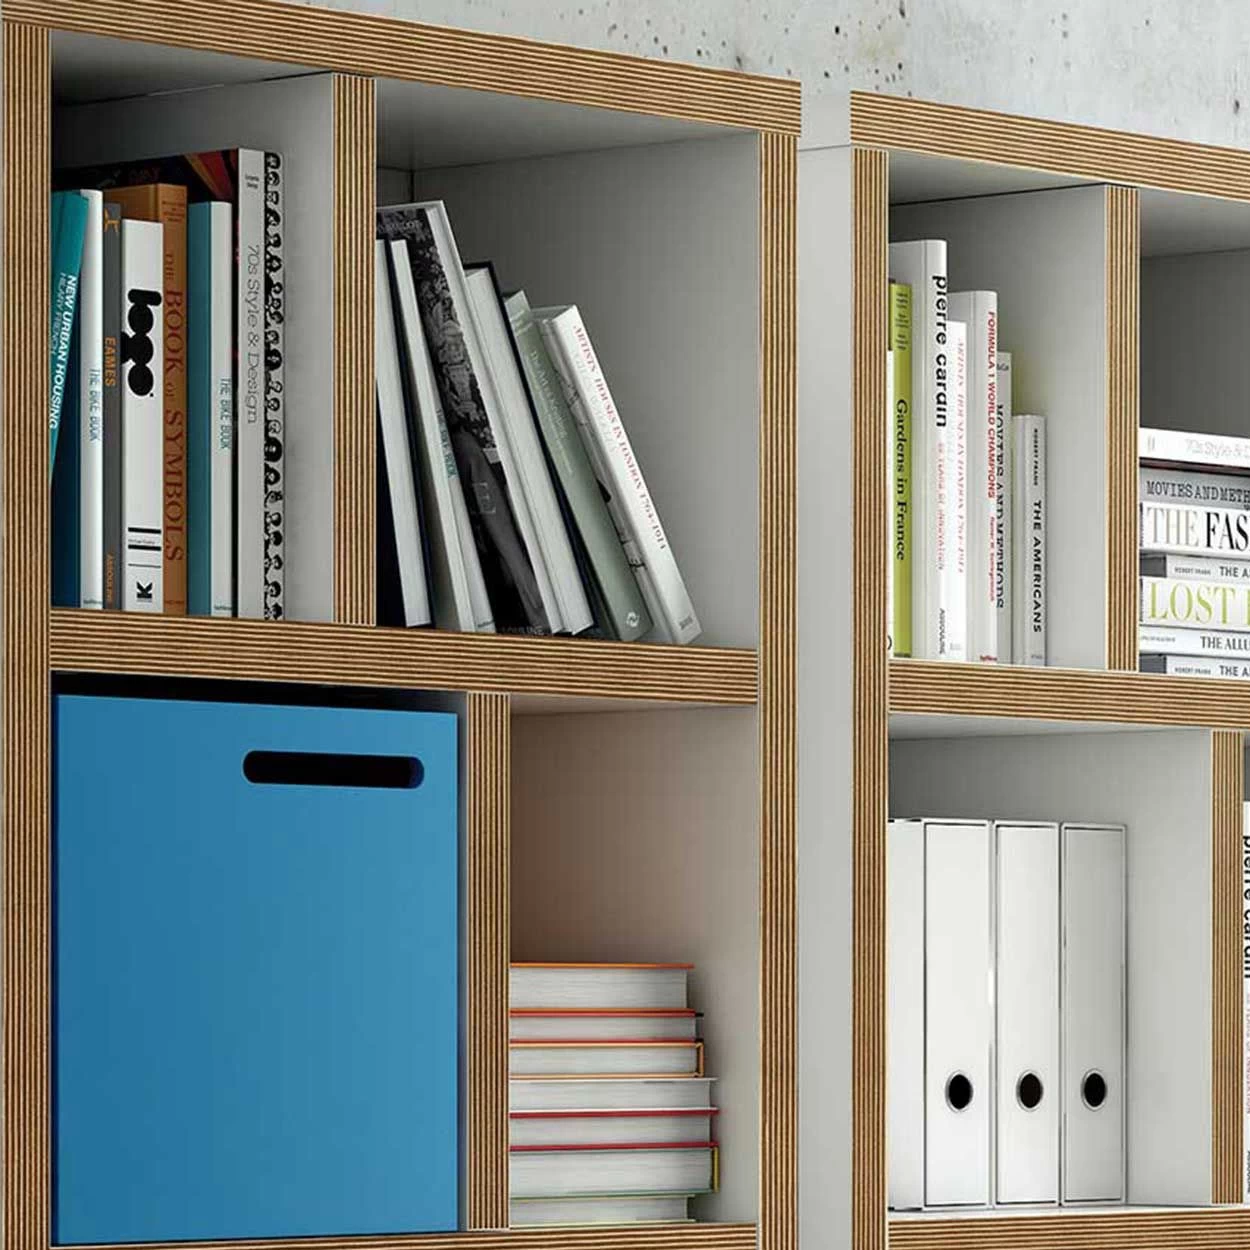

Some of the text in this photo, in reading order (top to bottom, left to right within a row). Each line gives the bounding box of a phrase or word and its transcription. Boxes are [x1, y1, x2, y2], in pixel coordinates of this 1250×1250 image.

[48, 274, 77, 429] NEW URBAN HOUSING
[165, 289, 184, 373] BOOK
[245, 244, 260, 424] 70s Style & Design
[932, 275, 948, 428] pierre cardin
[987, 311, 996, 368] FORMULA
[90, 368, 100, 385] THE
[104, 337, 117, 387] EAMES
[90, 416, 101, 442] BOOK
[220, 378, 232, 449] THE BIKE BOOK
[988, 382, 996, 425] WORLD
[165, 409, 184, 561] SYMBOLS
[896, 400, 908, 561] Gardens in France
[988, 428, 996, 499] CHAMPIONS
[1146, 480, 1193, 498] MOVIES
[1194, 485, 1219, 500] AND
[1147, 507, 1199, 547] THE
[1033, 500, 1042, 633] THE AMERICANS
[1219, 566, 1239, 577] THE
[1149, 582, 1236, 624] LOST
[1200, 636, 1222, 649] THE
[1219, 665, 1239, 677] THE
